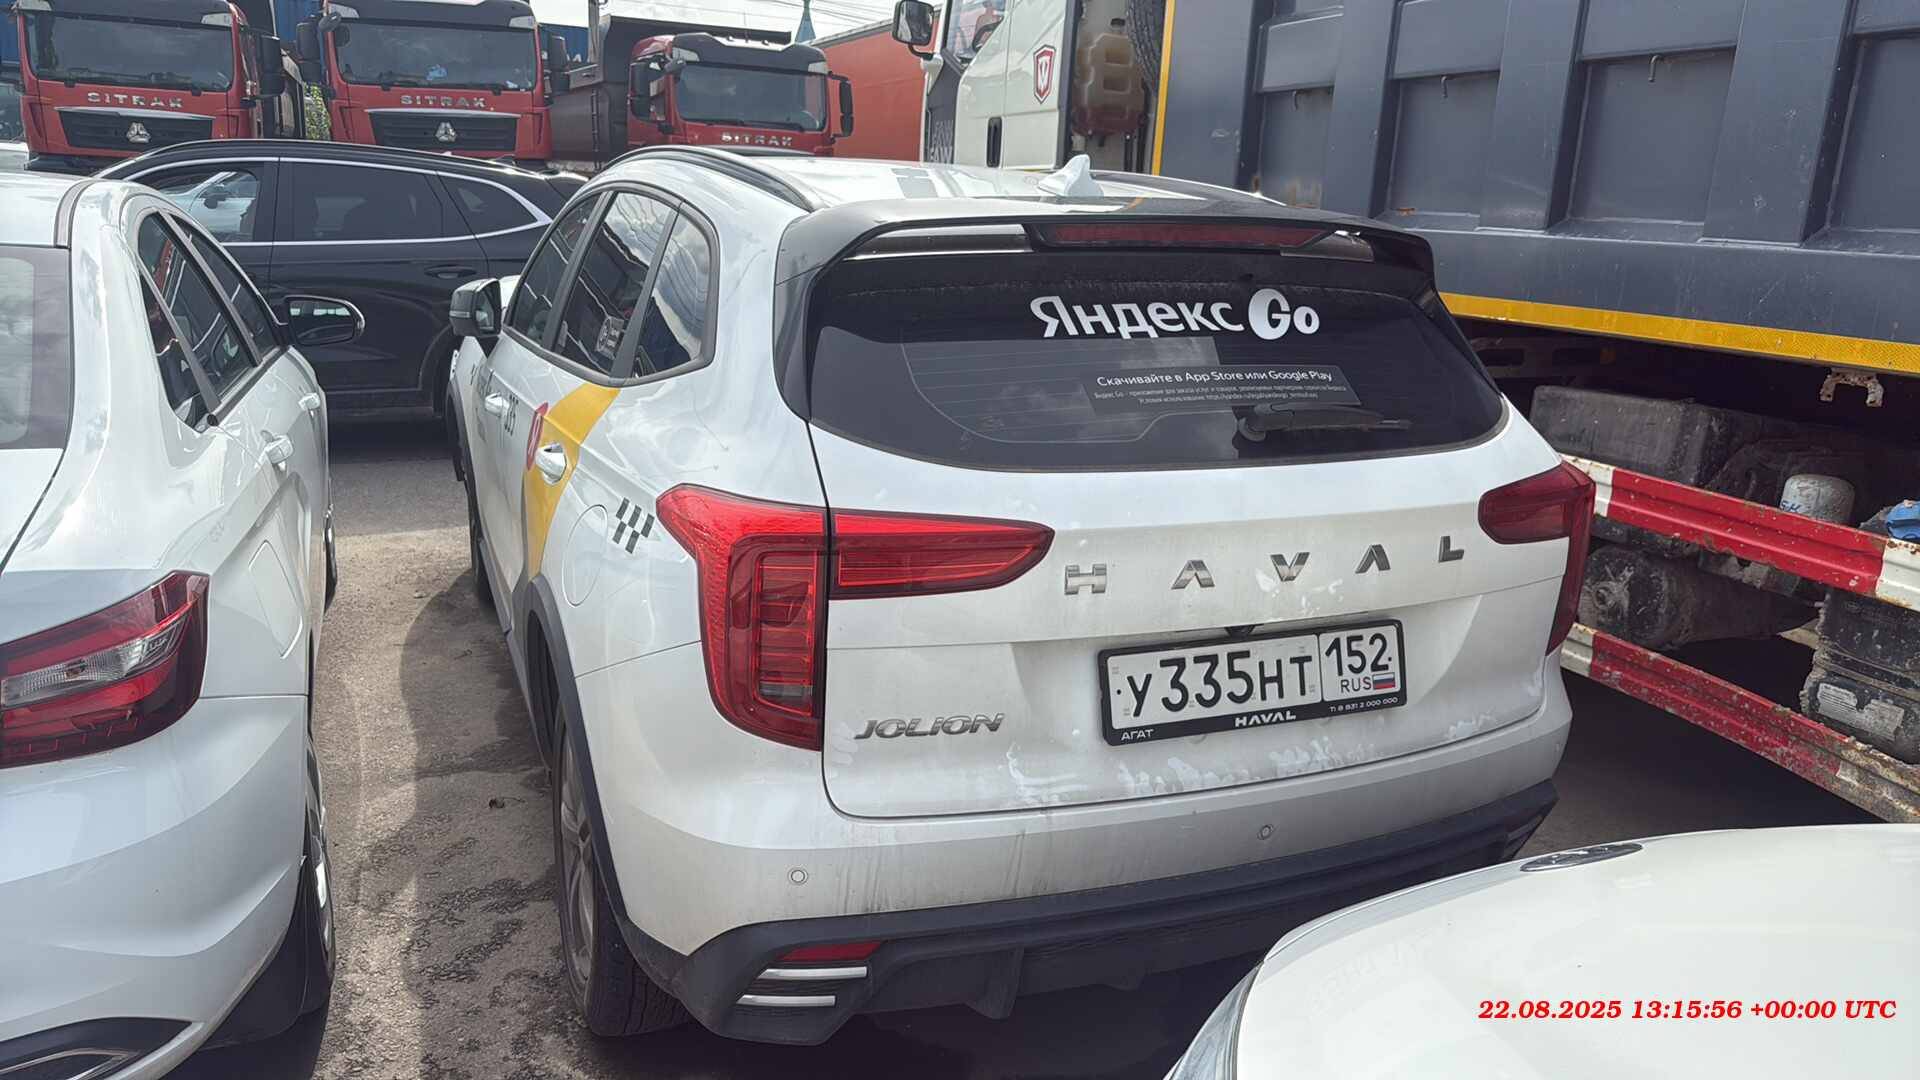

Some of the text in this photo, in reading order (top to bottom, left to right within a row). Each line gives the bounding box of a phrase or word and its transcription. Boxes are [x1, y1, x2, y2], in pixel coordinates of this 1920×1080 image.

[87, 92, 183, 108] SITRAK
[400, 95, 485, 108] SITRAK
[1029, 287, 1321, 341] Яндекс Go
[1096, 370, 1333, 387] Скачивайте в App Store или Google Play
[1064, 535, 1465, 596] HAVAL
[1126, 632, 1391, 718] У335НТ 152
[1340, 675, 1372, 692] RUS
[854, 712, 1005, 740] JOLION
[1234, 711, 1297, 729] HAVAL
[1121, 729, 1155, 742] АГАТ
